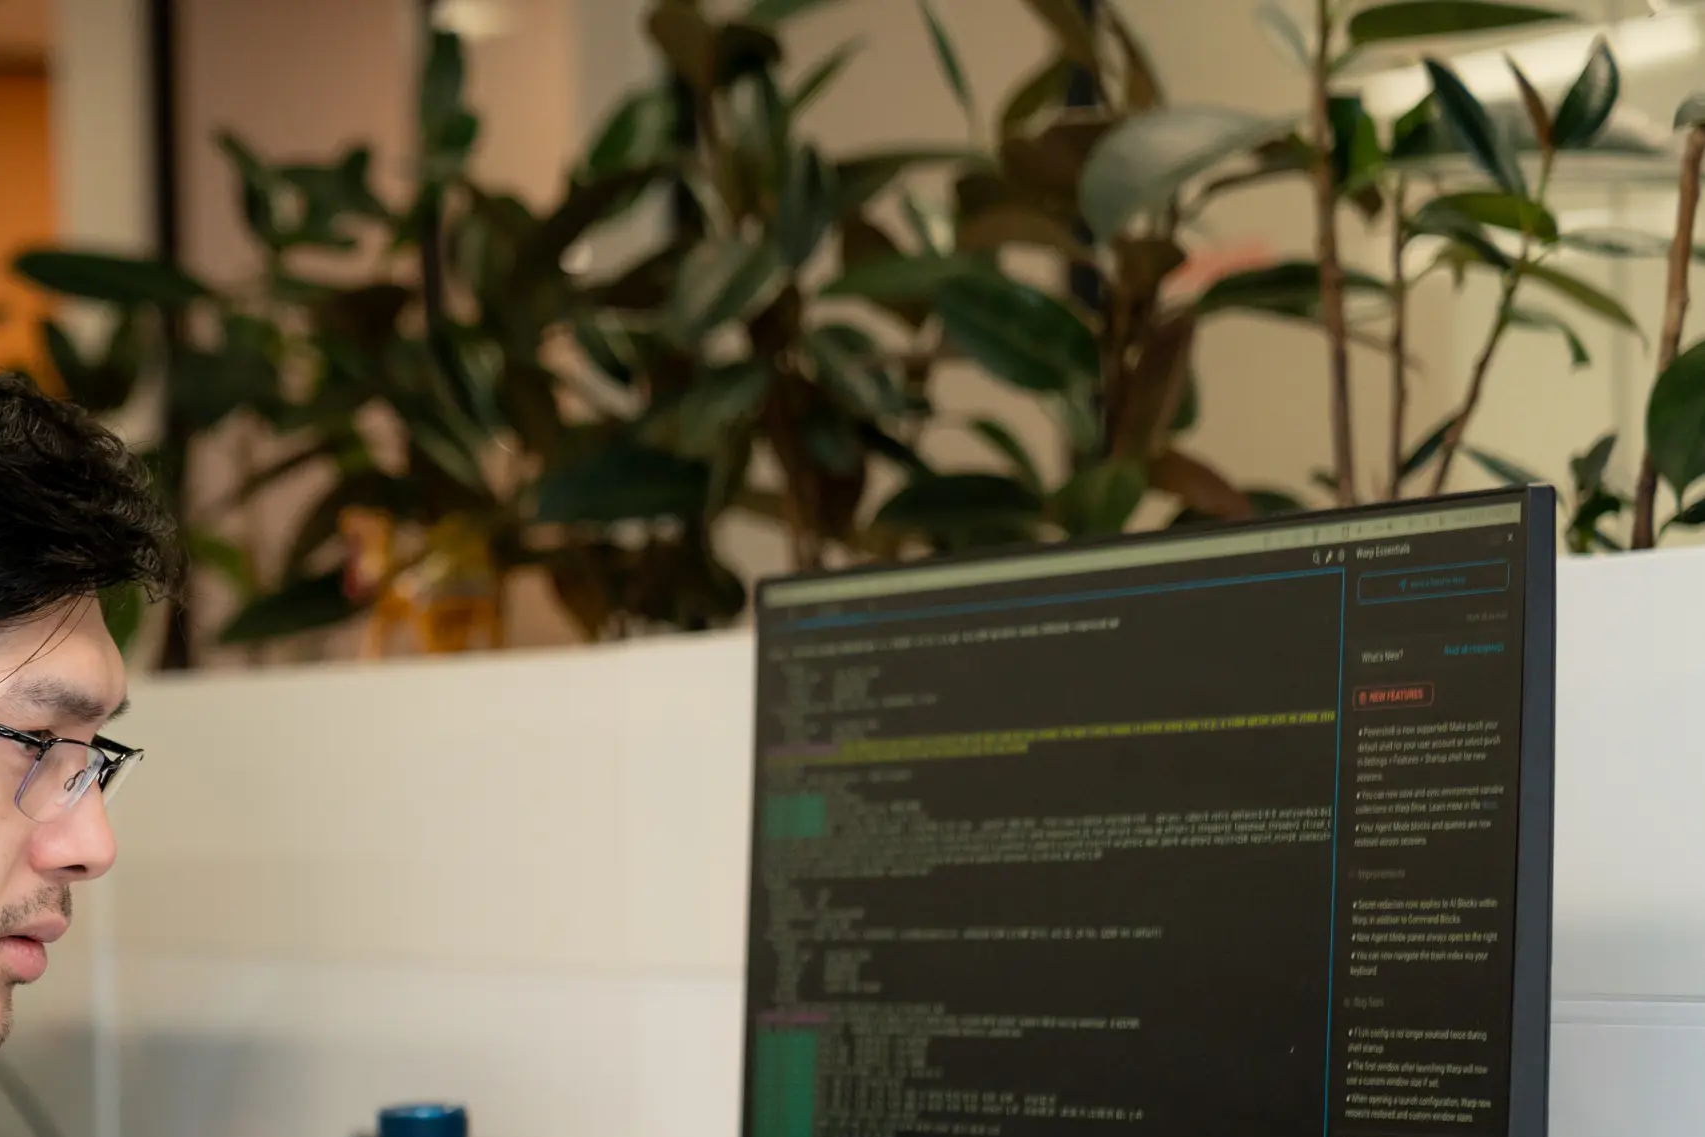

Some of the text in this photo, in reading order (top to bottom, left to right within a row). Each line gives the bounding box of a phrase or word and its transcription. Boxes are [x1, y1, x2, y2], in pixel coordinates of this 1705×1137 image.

[1356, 544, 1410, 559] Warp Essentials
[1362, 649, 1403, 663] What's New?
[1370, 689, 1423, 702] NEW FEATURES
